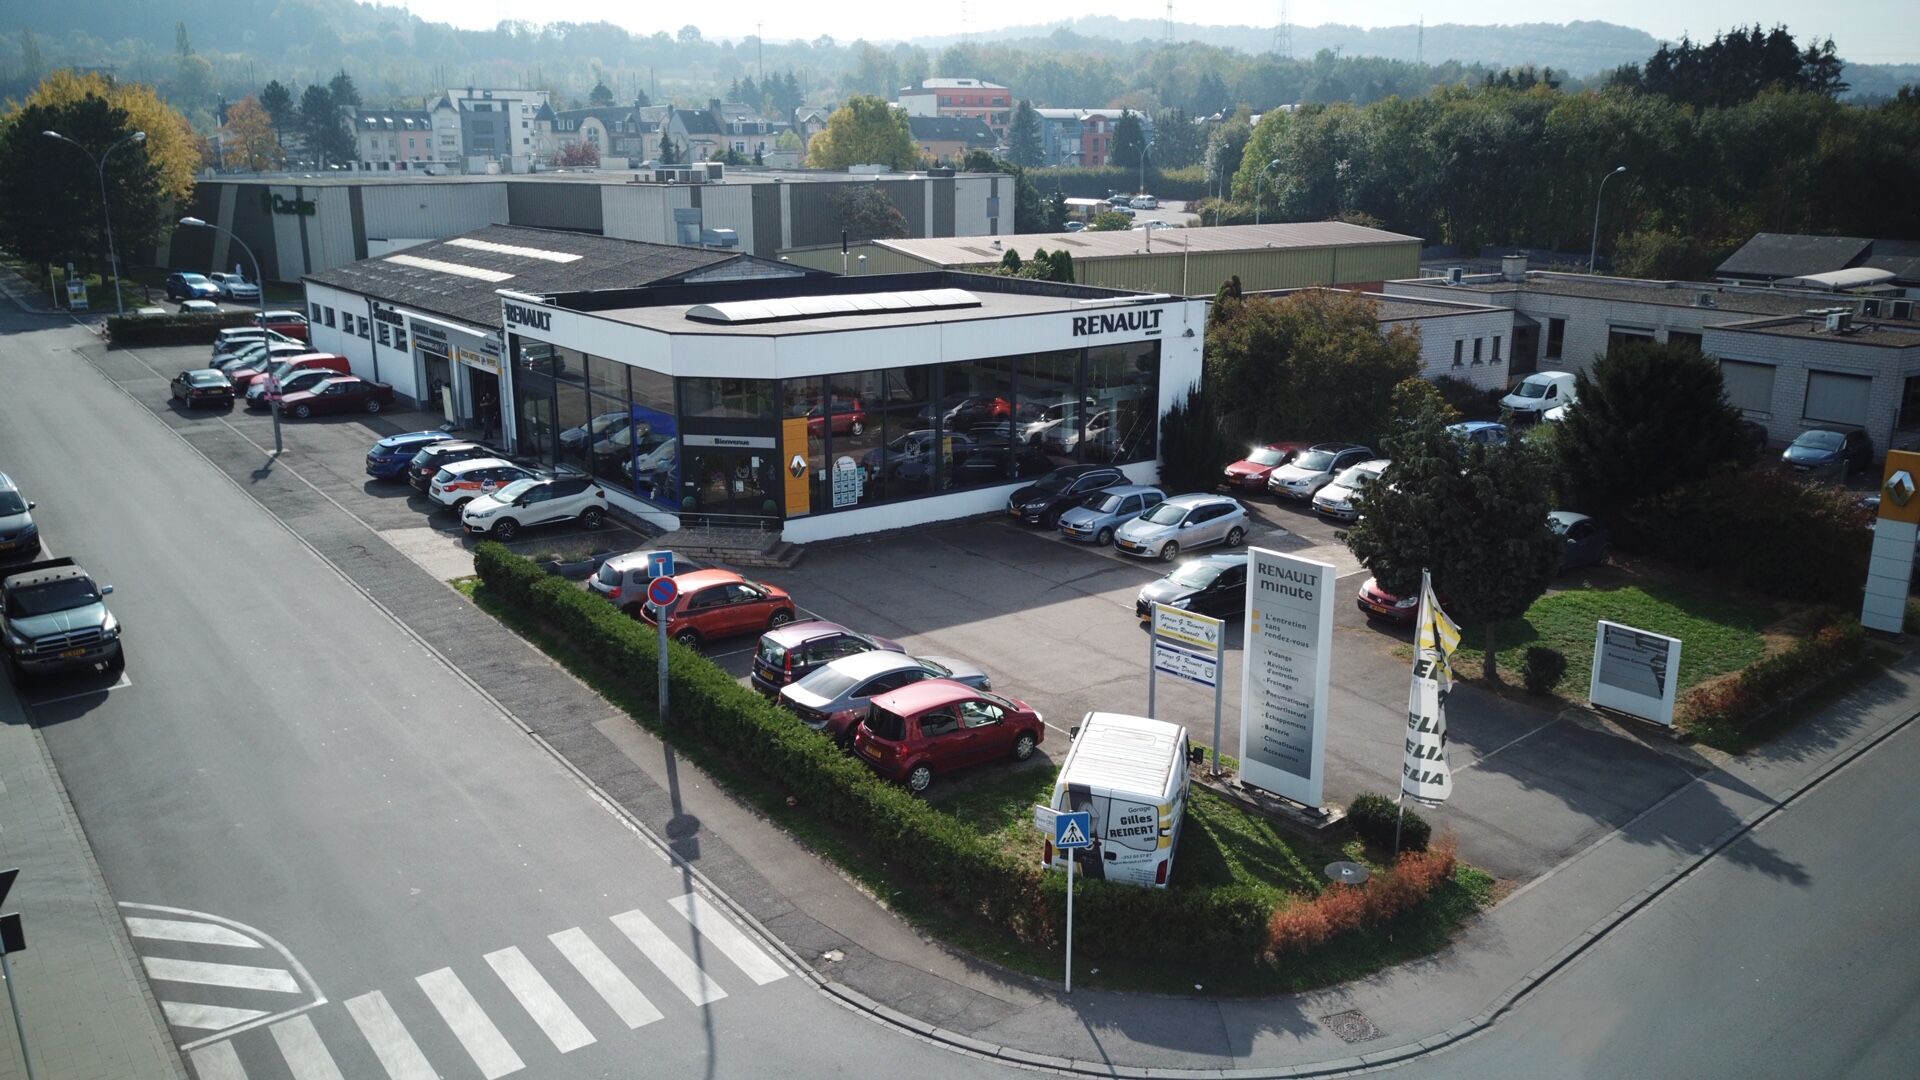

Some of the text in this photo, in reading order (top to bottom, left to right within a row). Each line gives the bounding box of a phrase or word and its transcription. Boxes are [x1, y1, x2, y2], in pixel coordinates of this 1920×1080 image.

[505, 302, 551, 332] RENAULT
[1073, 309, 1163, 336] RENAULT
[714, 437, 750, 446] Bienvenue
[1258, 563, 1318, 586] RENAULT
[1260, 579, 1313, 601] minute
[1265, 613, 1307, 630] L'entretien
[1265, 623, 1281, 632] sans
[1264, 631, 1309, 648] rendez-vous
[1267, 649, 1292, 661] Vidange
[1266, 668, 1299, 682] d'entretien
[1266, 677, 1292, 691] Freinage
[1265, 690, 1310, 708] Pneumatiques
[1265, 701, 1307, 719] Amortisseurs
[1264, 724, 1290, 737] Batterie
[1408, 711, 1439, 735] EL
[1403, 762, 1444, 786] ELIA
[1128, 806, 1151, 814] Garage
[1120, 815, 1153, 825] Gilles
[1110, 825, 1154, 838] REINERT
